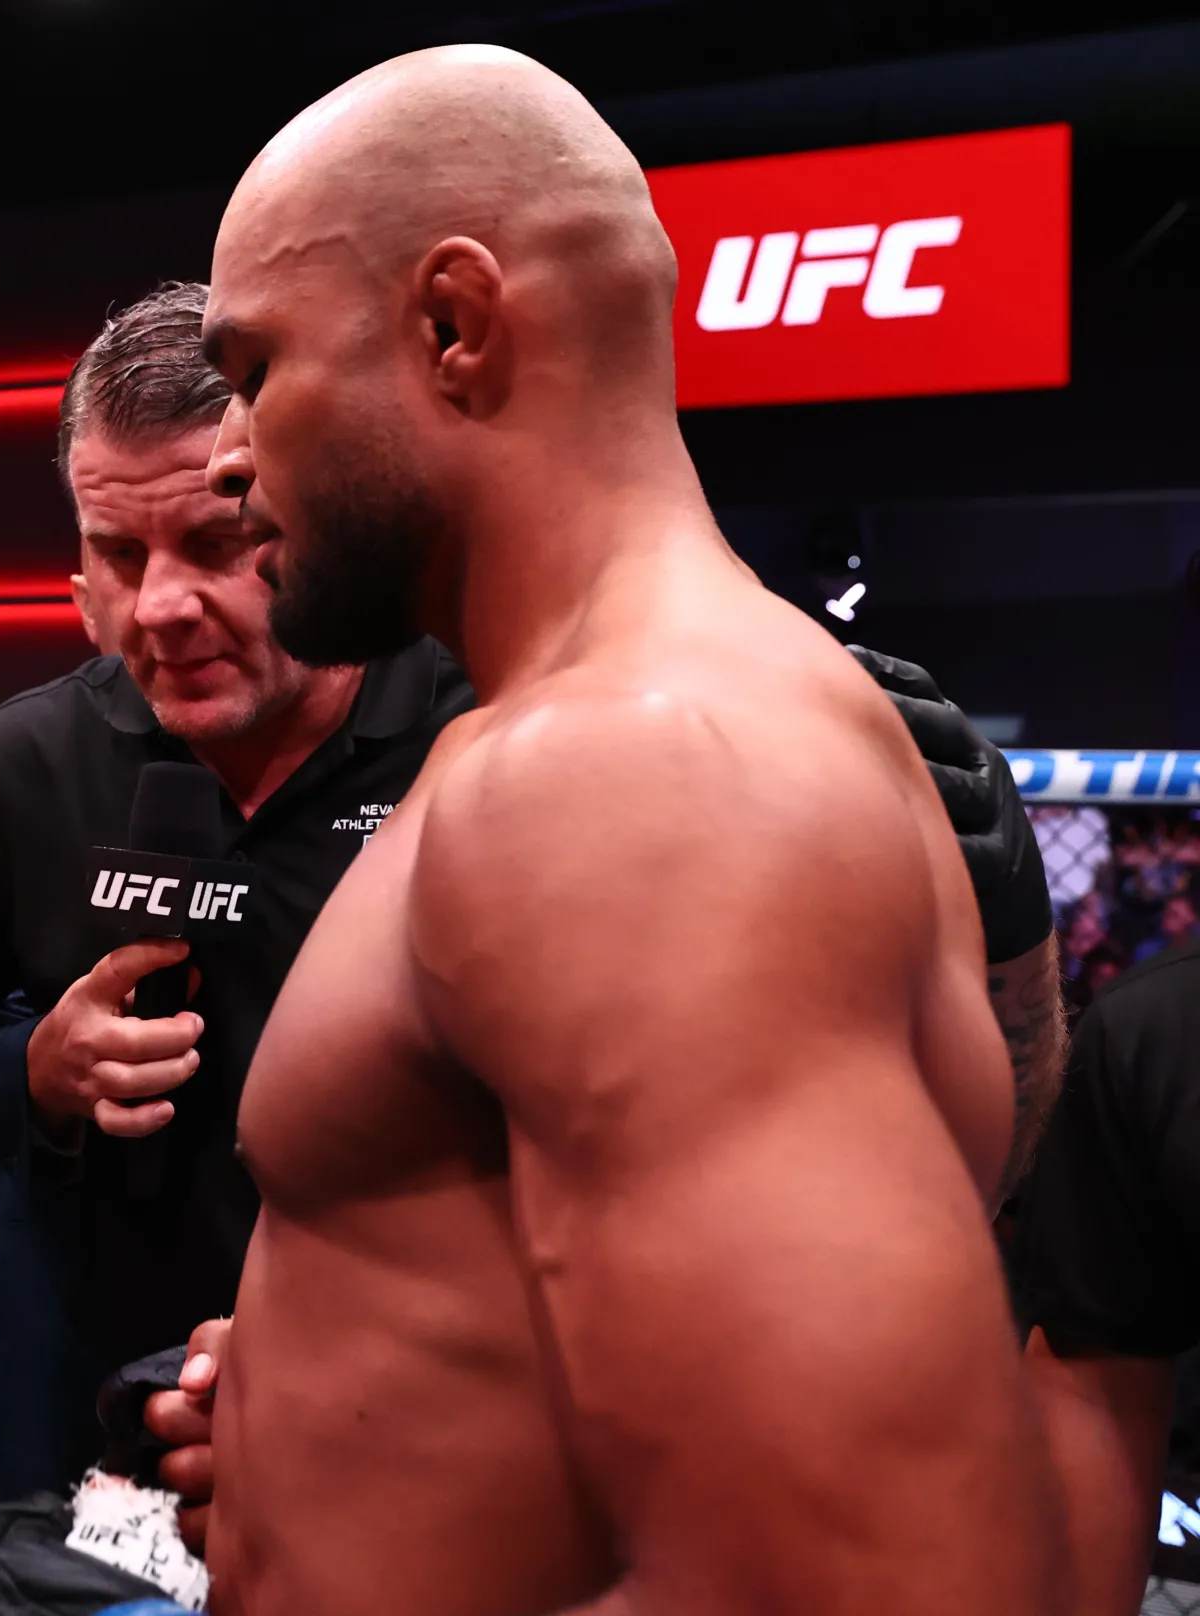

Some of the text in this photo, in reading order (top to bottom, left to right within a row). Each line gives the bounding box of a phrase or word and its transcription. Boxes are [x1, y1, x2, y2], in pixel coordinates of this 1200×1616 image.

[696, 216, 963, 332] UFC
[332, 819, 385, 831] ATHLET
[360, 804, 400, 816] NEVA
[91, 870, 180, 916] UFC
[188, 881, 249, 922] UFC
